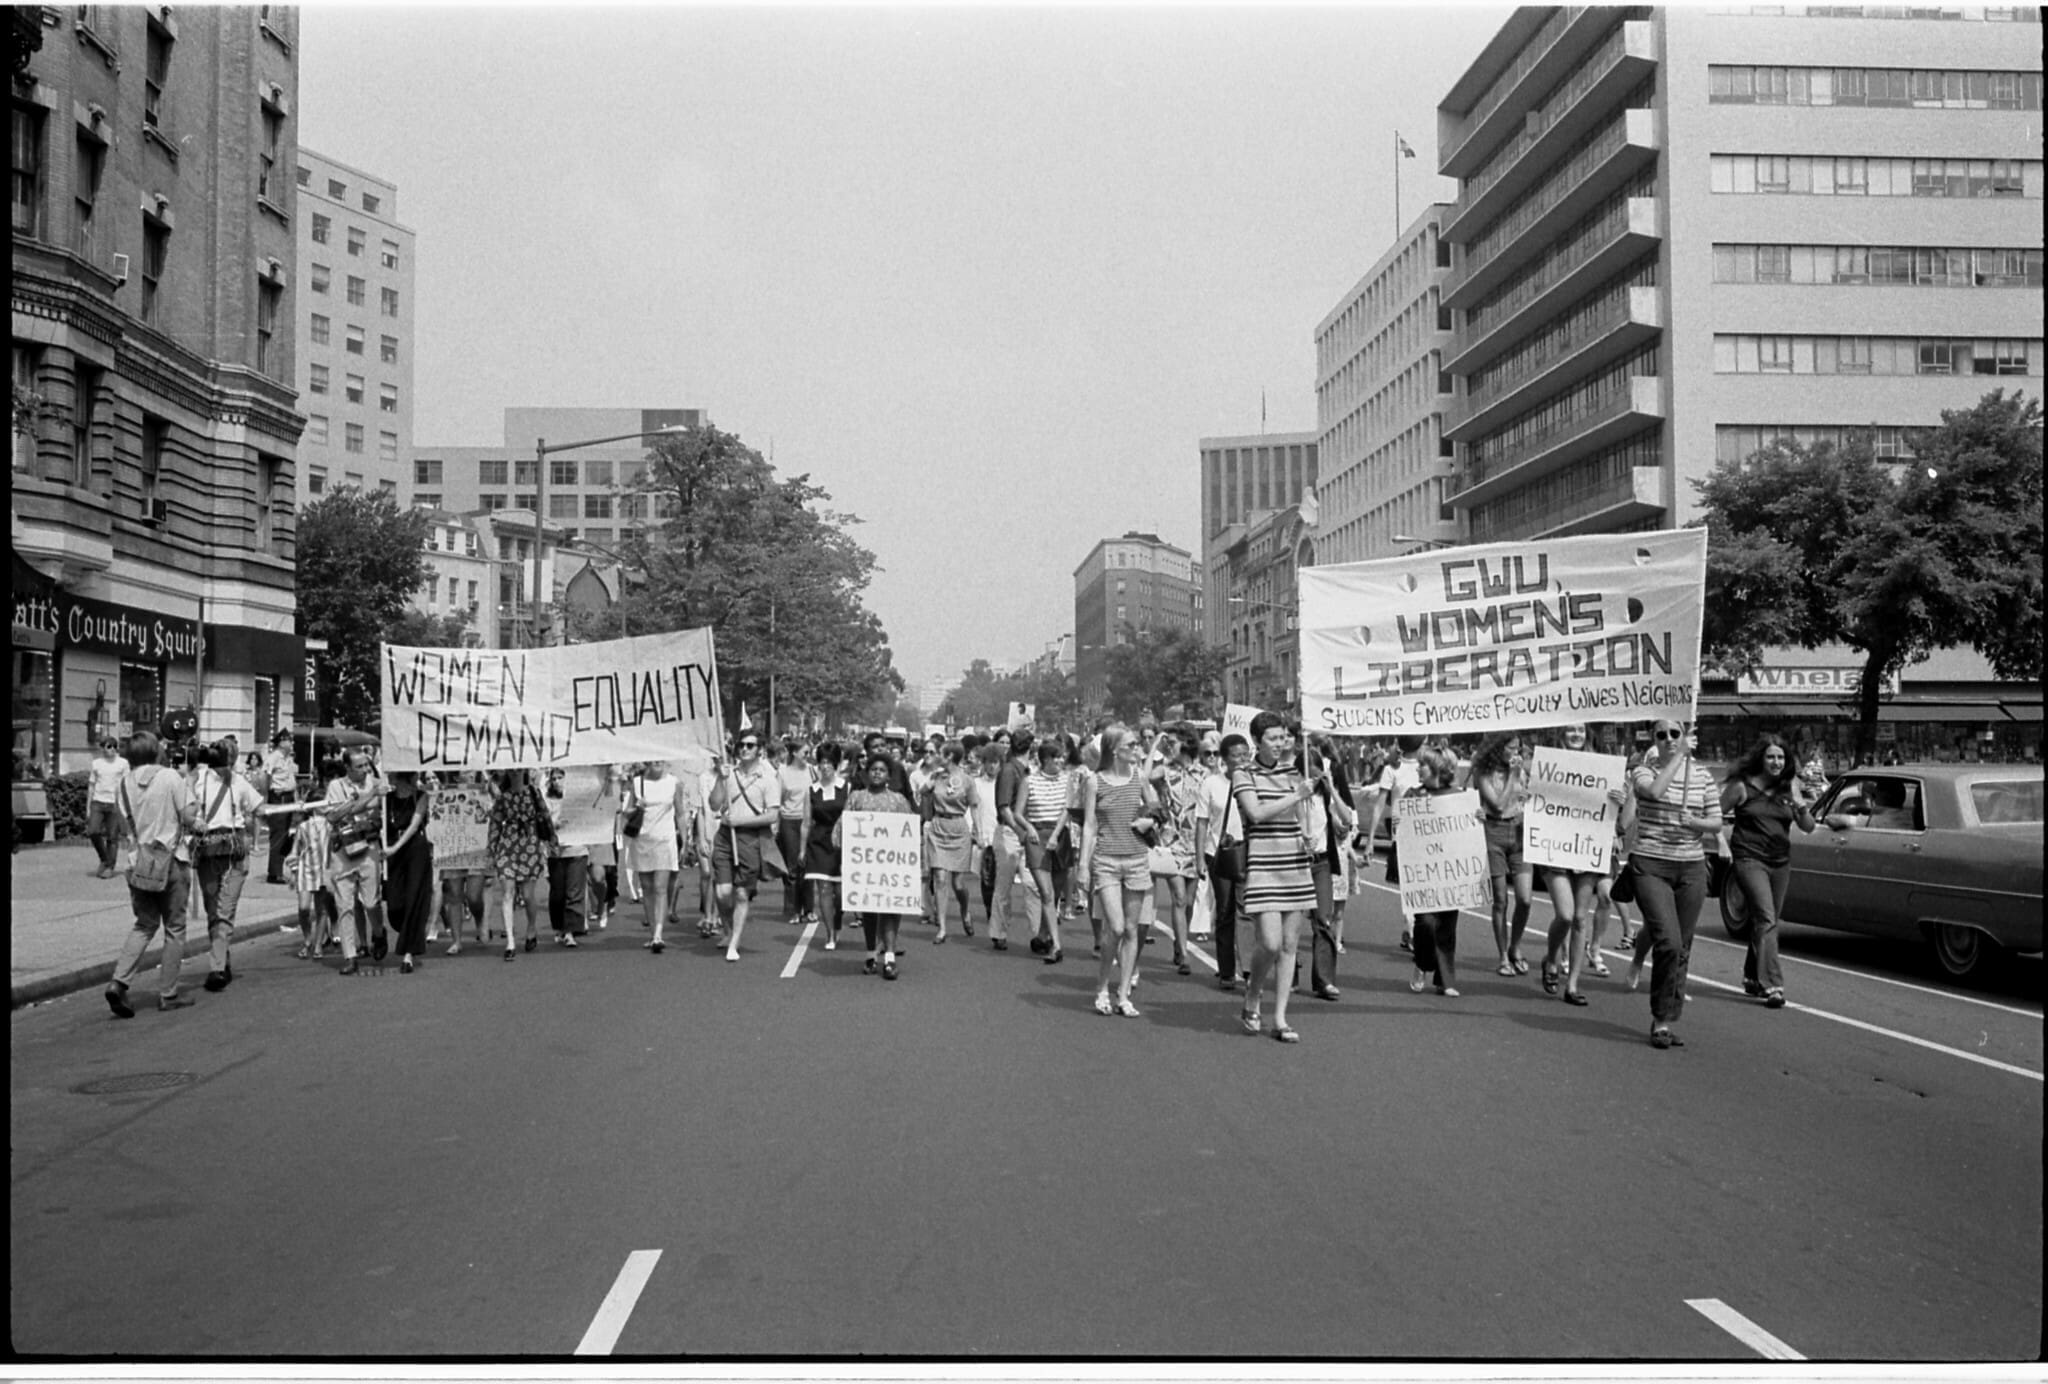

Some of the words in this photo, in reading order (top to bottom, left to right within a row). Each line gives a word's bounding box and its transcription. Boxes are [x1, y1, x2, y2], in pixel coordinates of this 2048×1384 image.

[1441, 553, 1548, 602] GWU
[69, 604, 147, 655] Country
[388, 647, 525, 707] WOMEN
[1333, 632, 1672, 700] LIBERATION
[1750, 668, 1865, 686] Whela
[573, 663, 714, 736] EQUALITY
[418, 710, 573, 765] DEMAND
[1538, 761, 1608, 790] Women
[1399, 799, 1434, 816] FREE
[1533, 794, 1606, 822] Demand
[901, 821, 912, 838] A
[1413, 814, 1476, 837] ABORTION
[851, 846, 918, 866] SECOND
[1426, 842, 1443, 855] ON
[1530, 827, 1603, 868] Equality
[850, 871, 912, 888] CLASS
[1403, 856, 1482, 884] DEMAND
